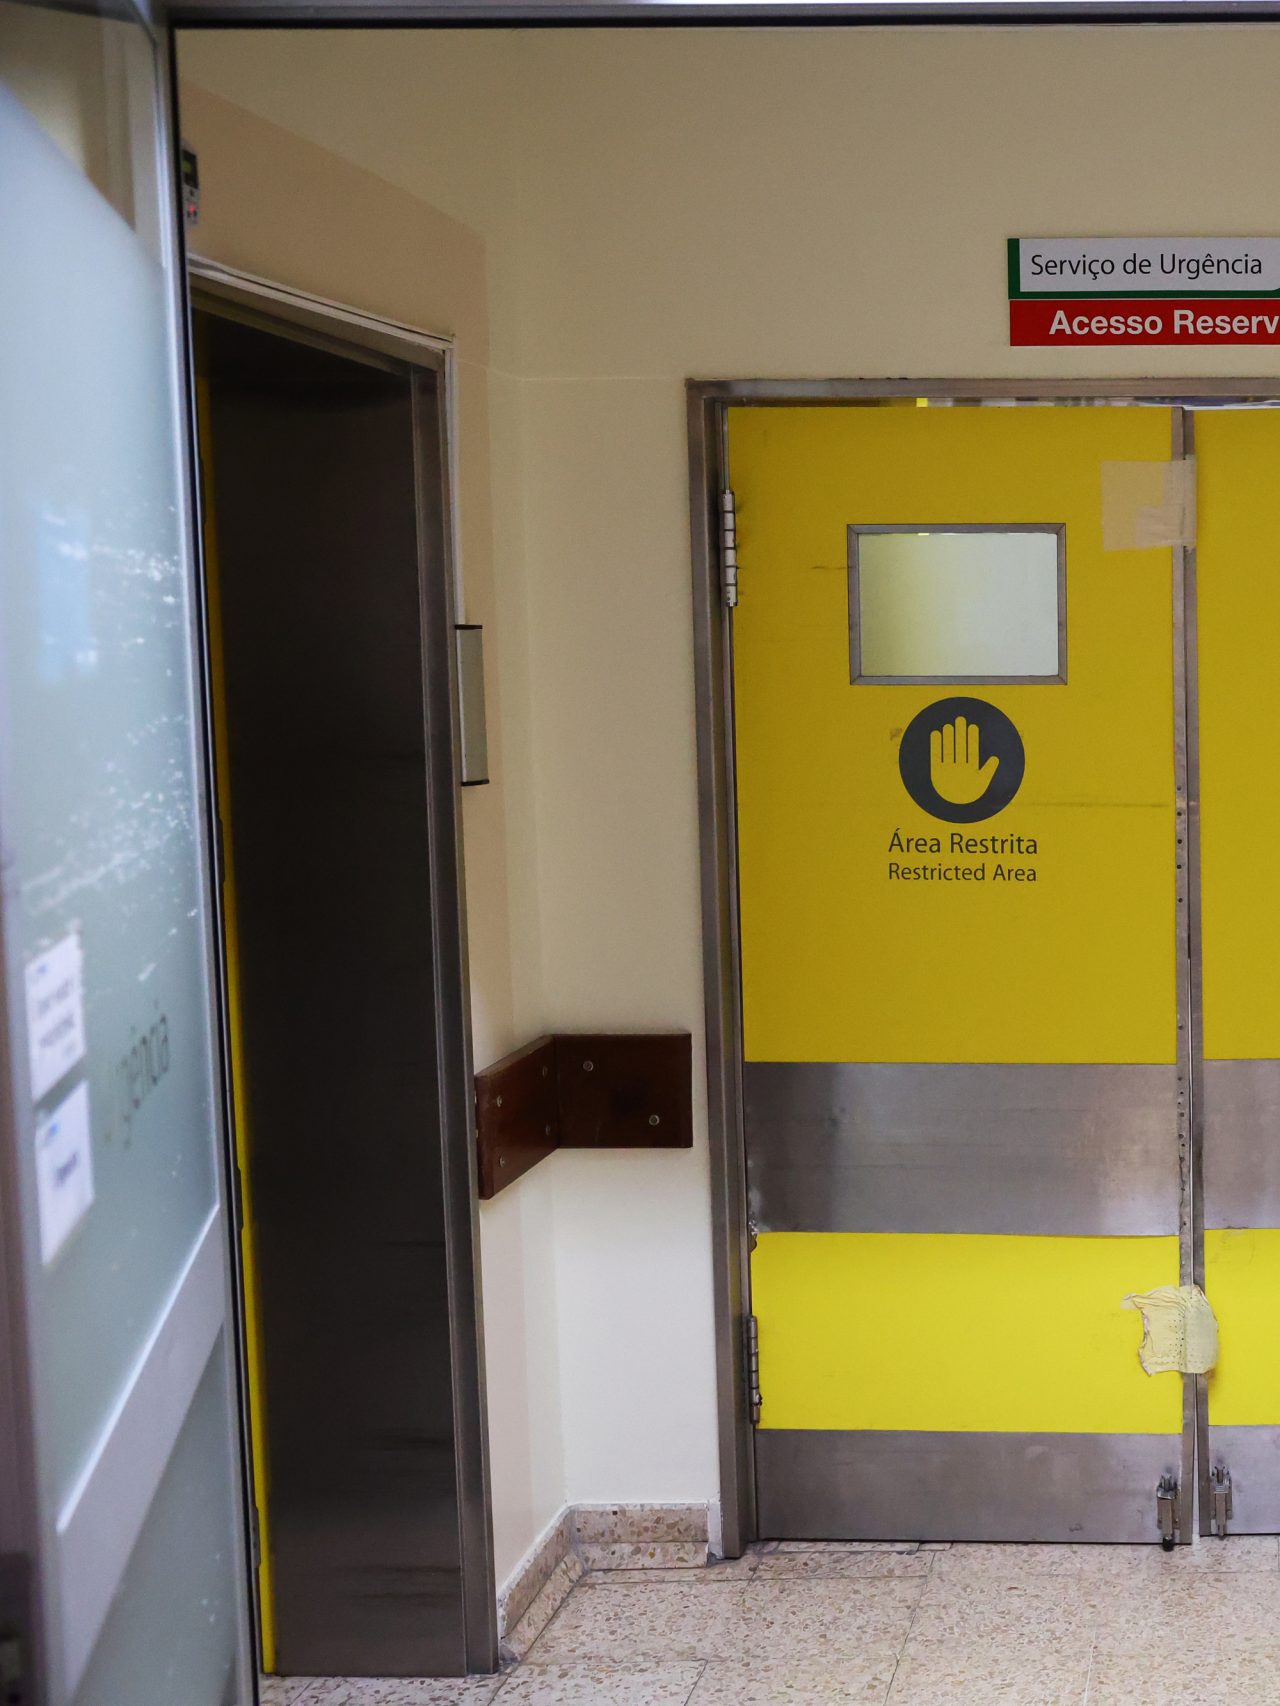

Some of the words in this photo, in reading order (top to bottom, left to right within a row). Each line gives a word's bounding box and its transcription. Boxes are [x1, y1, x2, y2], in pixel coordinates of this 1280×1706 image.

[1031, 253, 1115, 281] Serviço
[1122, 252, 1152, 275] de
[1160, 252, 1263, 280] Urgência
[1048, 310, 1163, 335] Acesso
[888, 827, 941, 853] Área
[950, 832, 1038, 855] Restrita
[888, 862, 986, 881] Restricted
[992, 863, 1037, 882] Area
